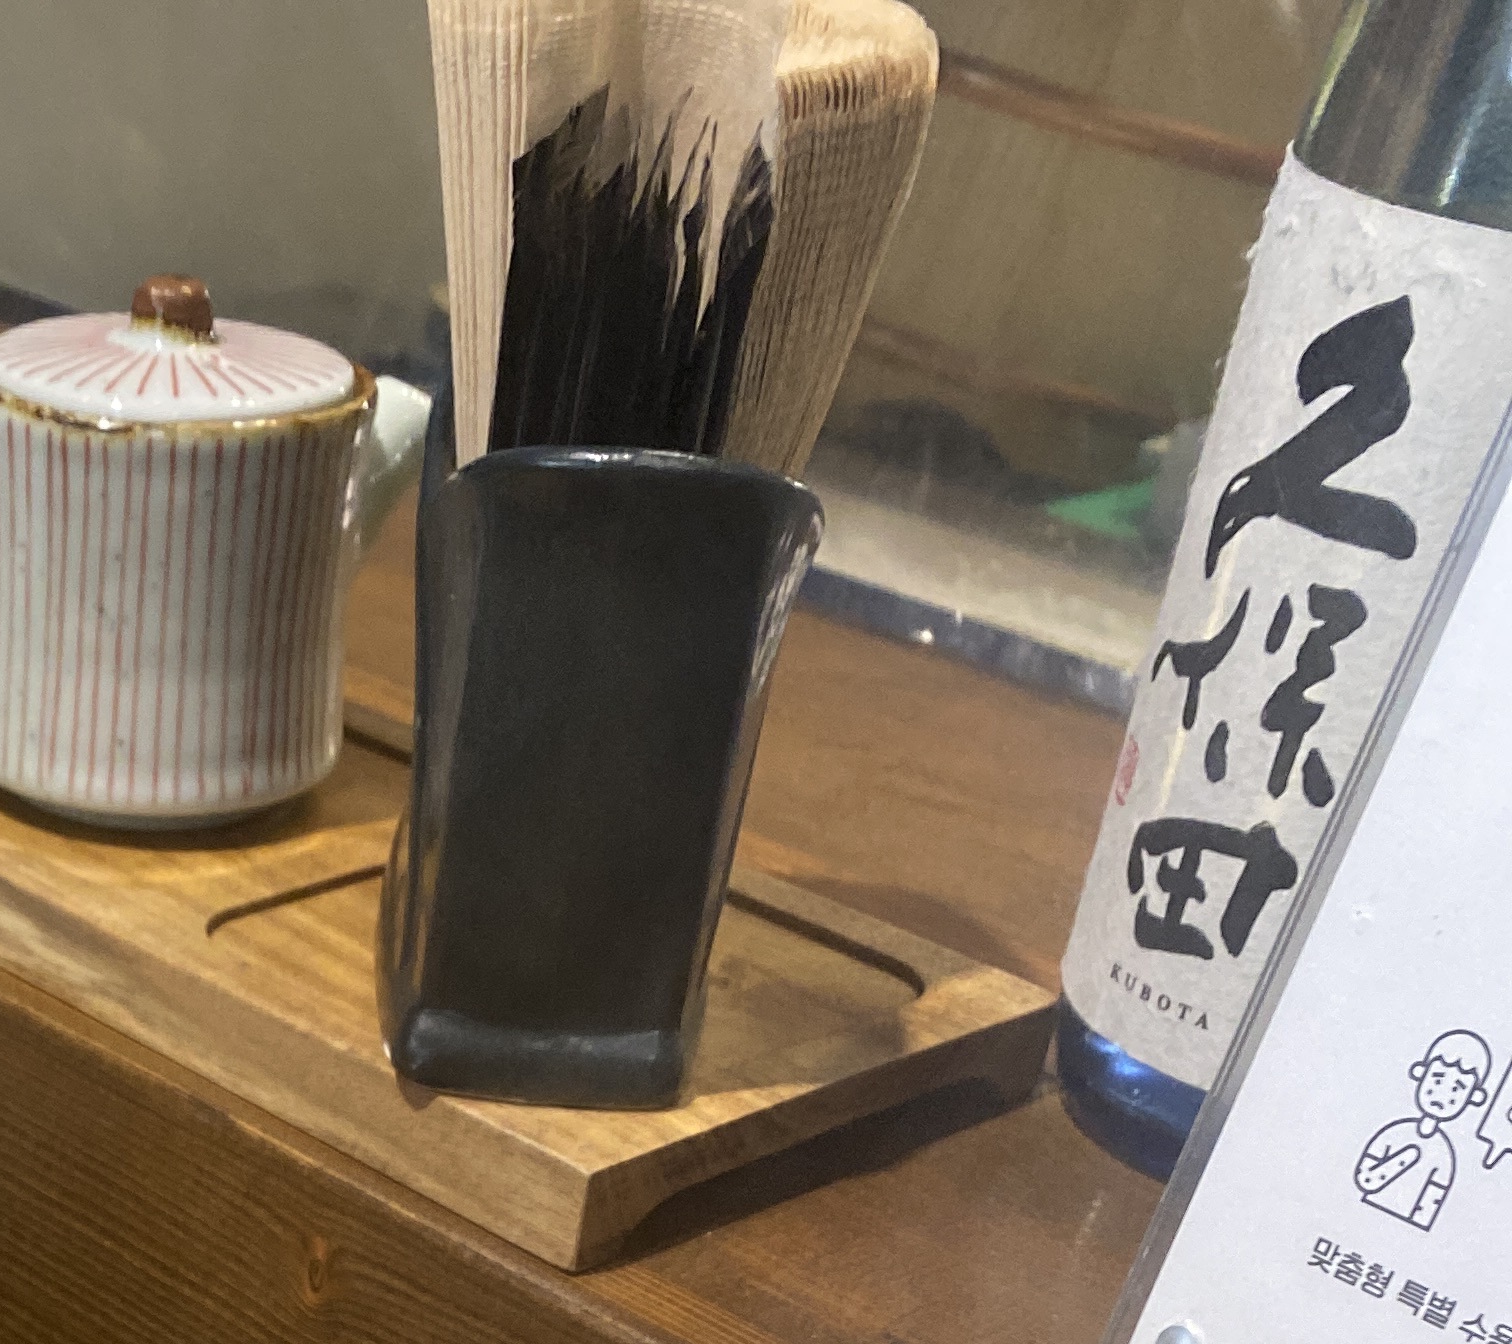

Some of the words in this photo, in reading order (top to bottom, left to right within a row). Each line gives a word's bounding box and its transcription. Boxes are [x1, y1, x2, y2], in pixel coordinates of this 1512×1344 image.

[1127, 294, 1419, 961] 久保田
[1109, 962, 1209, 1031] KUBOTA
[1306, 1236, 1396, 1299] 맞춤형
[1396, 1278, 1458, 1330] 특별
